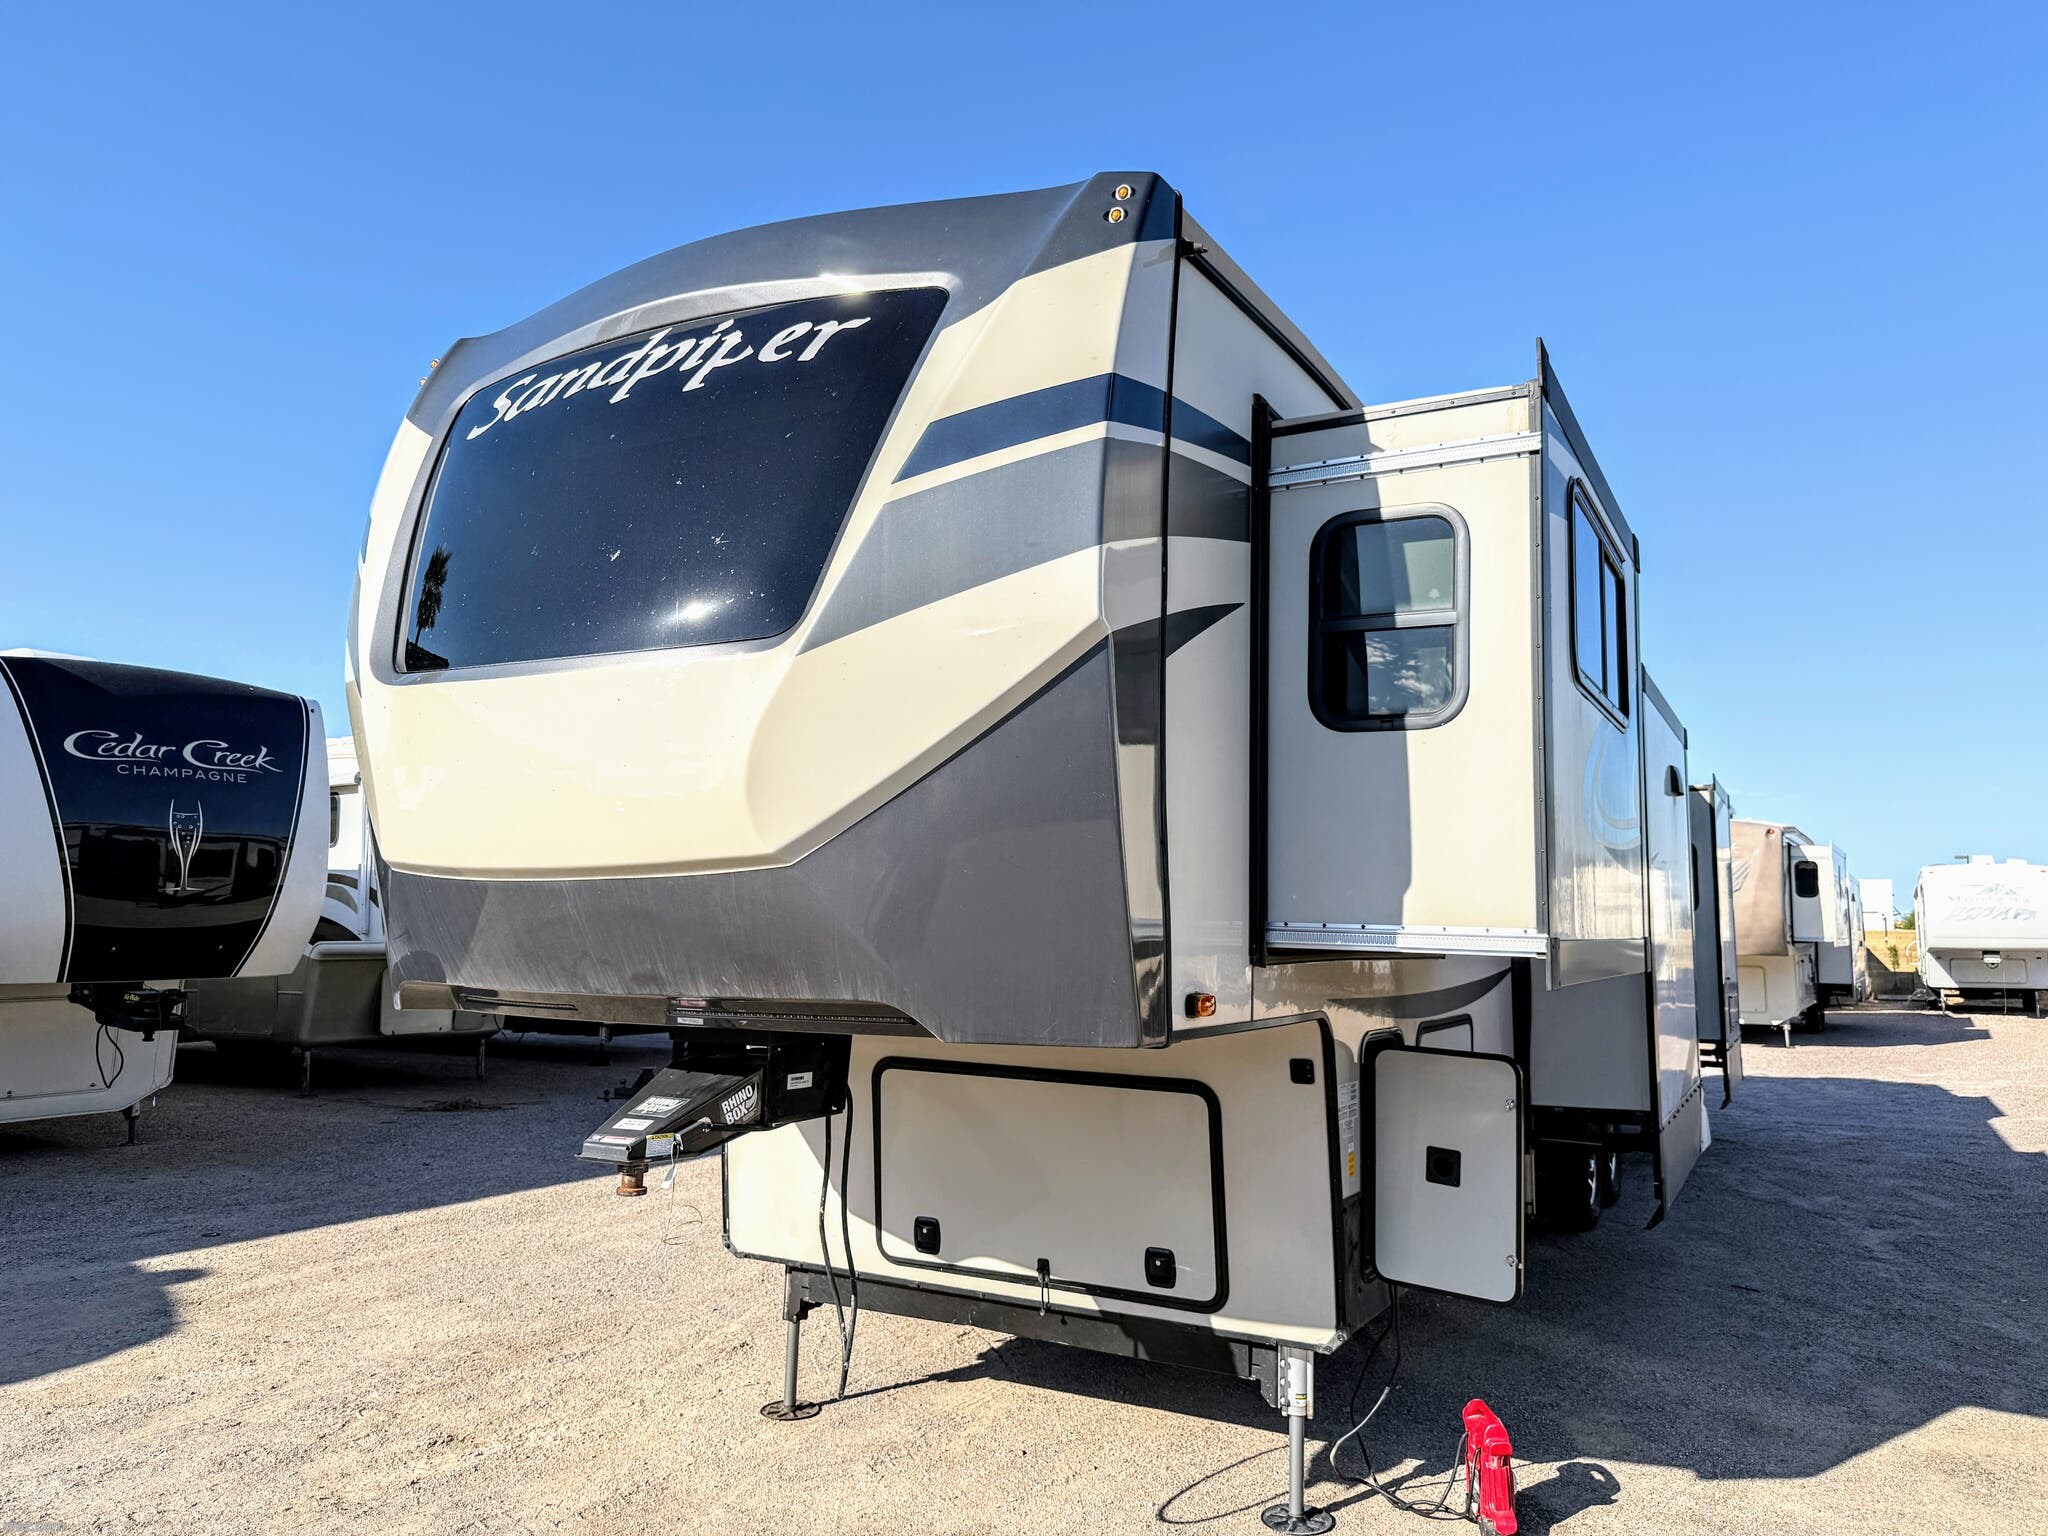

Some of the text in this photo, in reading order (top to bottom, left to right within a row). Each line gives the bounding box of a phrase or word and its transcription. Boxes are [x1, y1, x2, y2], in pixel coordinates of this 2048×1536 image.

[467, 319, 871, 440] Sandpiper
[63, 729, 283, 774] Cedar Creek
[116, 764, 247, 784] CHAMPAGNE
[721, 1085, 754, 1114] RHINO
[725, 1101, 749, 1126] BOX
